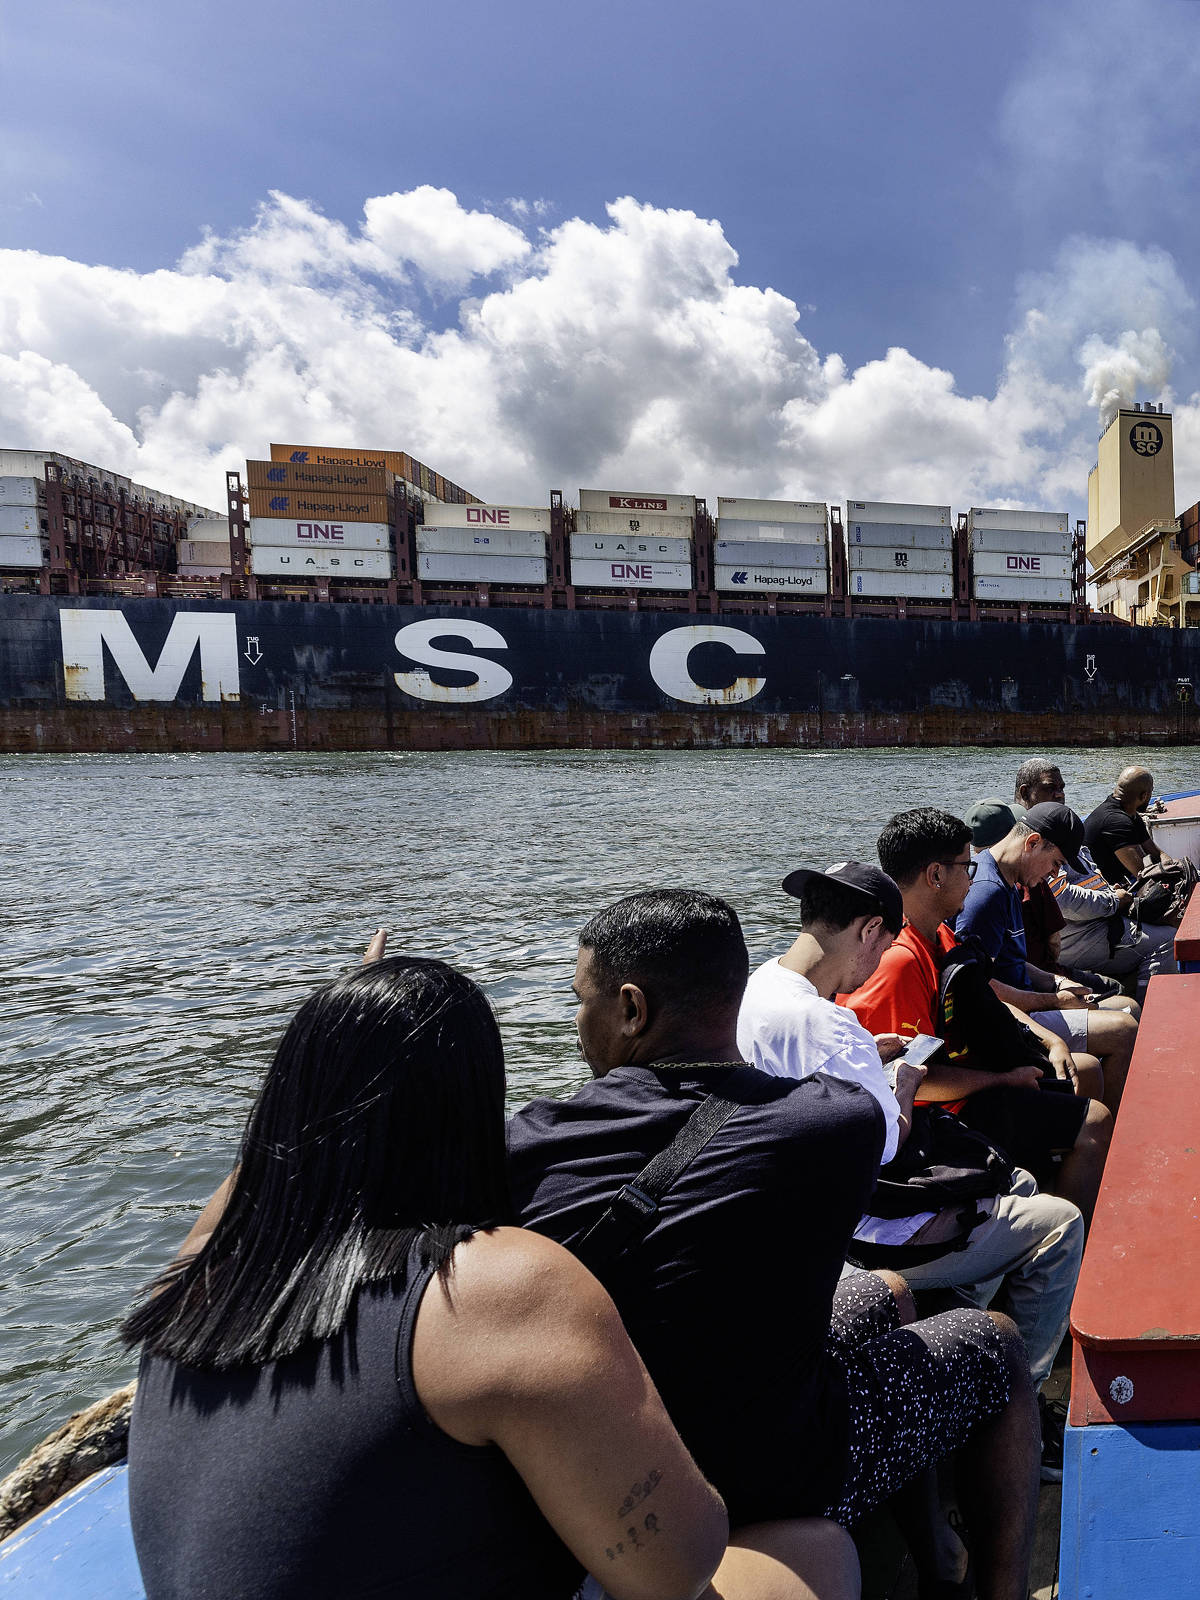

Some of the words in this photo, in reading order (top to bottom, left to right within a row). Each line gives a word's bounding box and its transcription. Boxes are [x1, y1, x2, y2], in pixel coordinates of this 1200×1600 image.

[295, 472, 367, 486] Hapag-Lloyd
[297, 501, 370, 514] Hapag-Lloyd
[634, 502, 663, 510] LINE
[466, 508, 510, 524] ONE
[297, 523, 344, 540] ONE
[1006, 556, 1041, 570] ONE
[611, 564, 653, 579] ONE
[754, 574, 813, 586] Hapag-Lloyd
